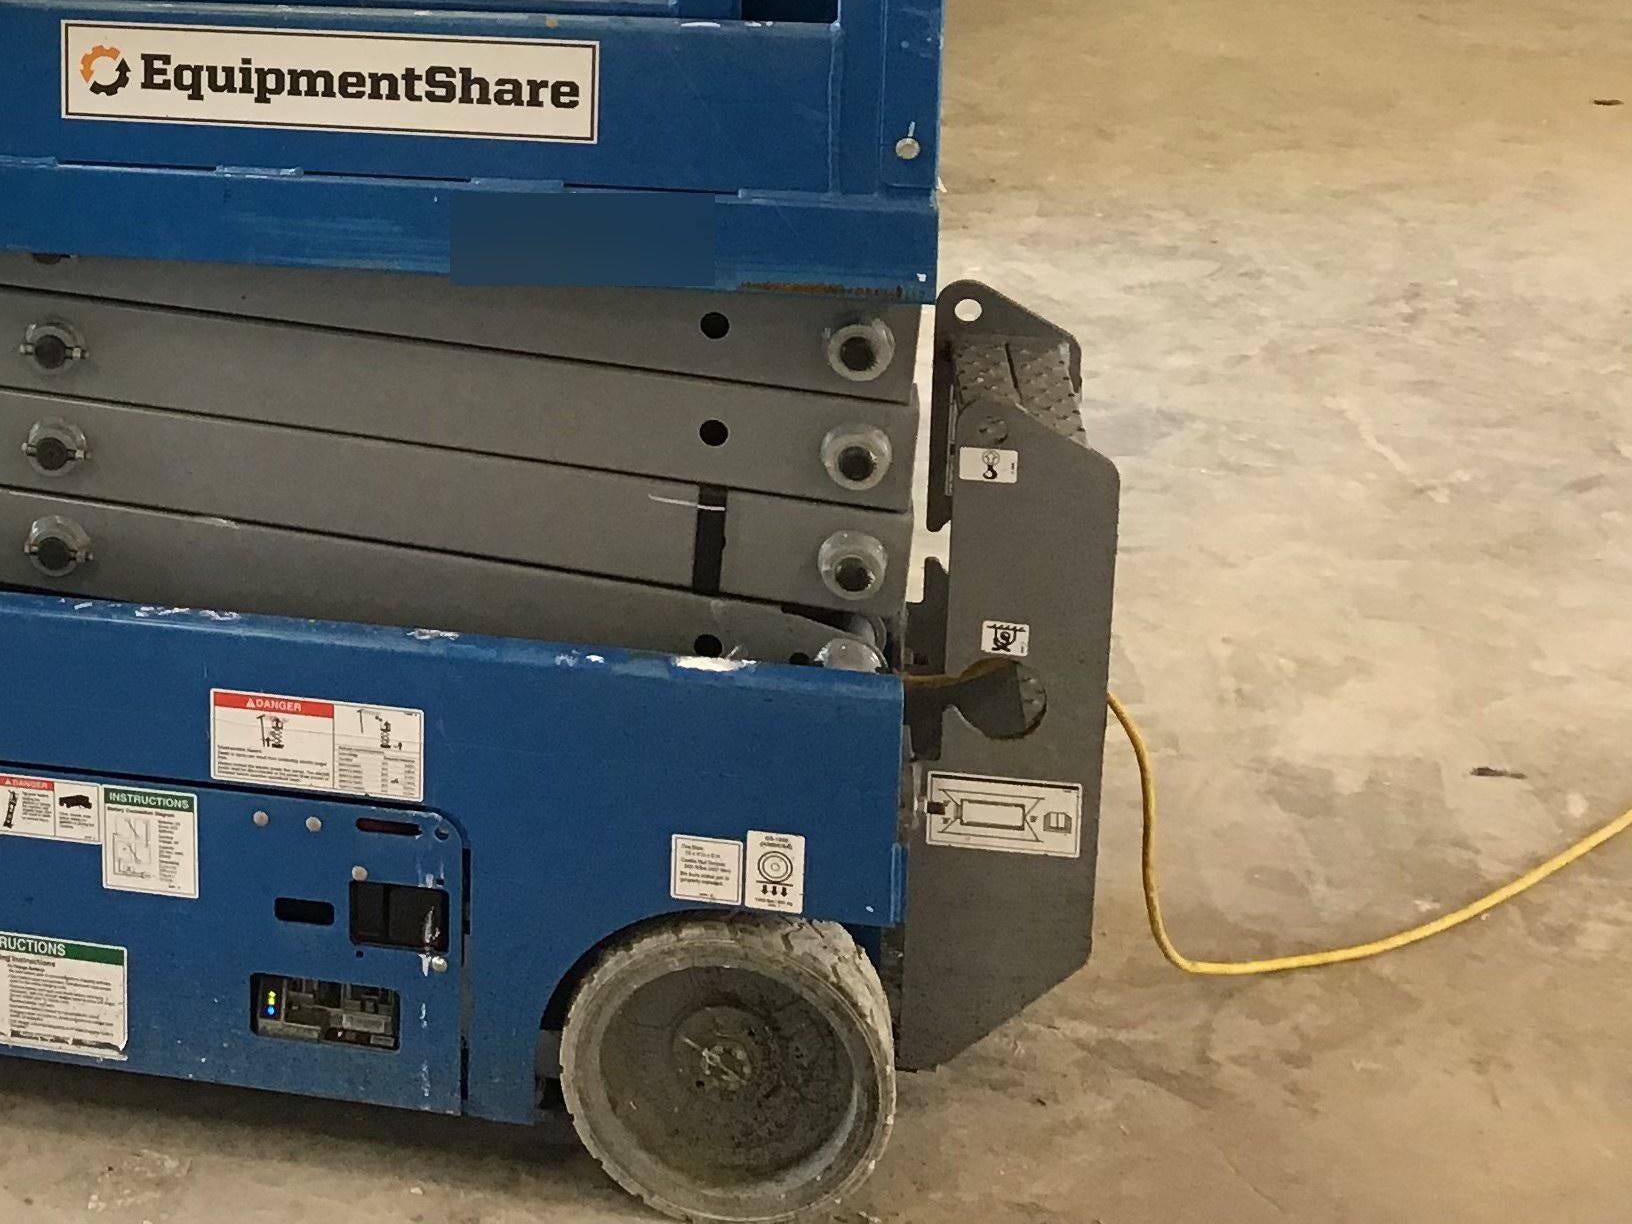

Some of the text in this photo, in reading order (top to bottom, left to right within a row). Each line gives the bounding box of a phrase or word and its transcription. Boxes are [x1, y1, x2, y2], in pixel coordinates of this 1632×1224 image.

[139, 52, 582, 111] EquipmentShare
[255, 698, 302, 712] DANGER
[12, 778, 48, 789] DANGER
[109, 792, 190, 809] INSTRUCTIONS
